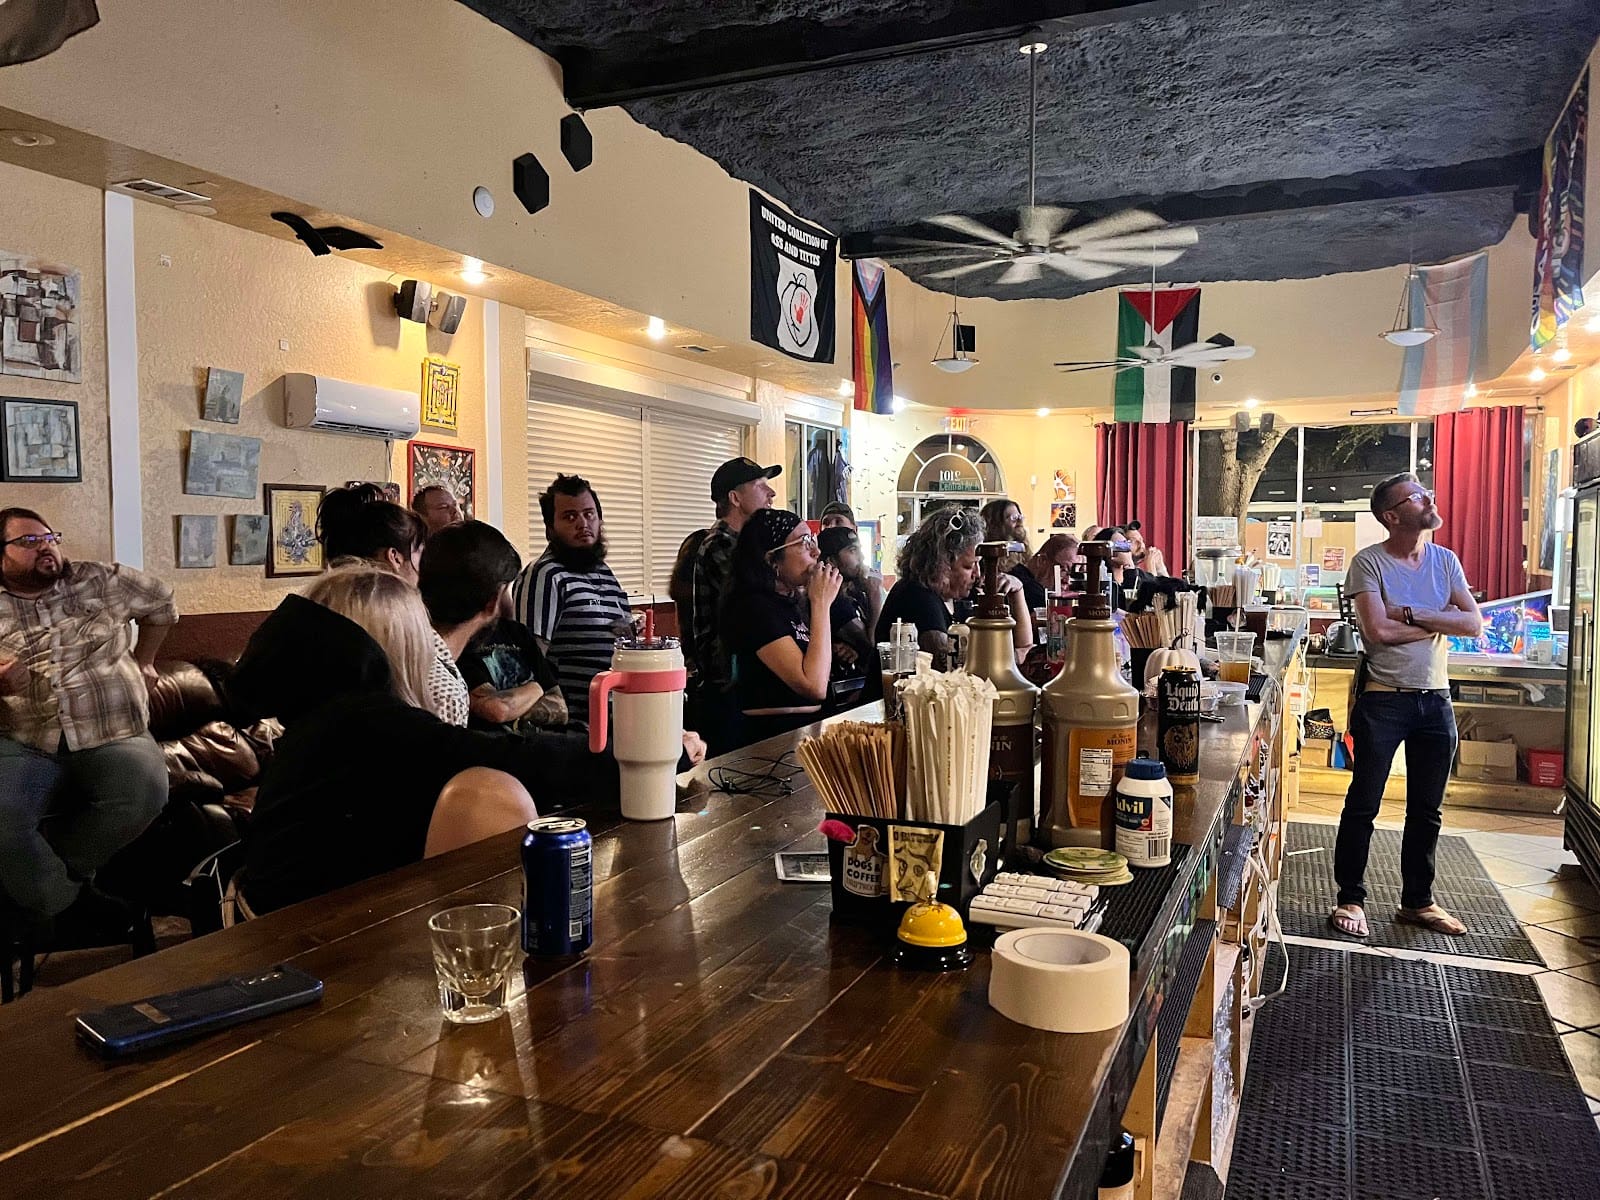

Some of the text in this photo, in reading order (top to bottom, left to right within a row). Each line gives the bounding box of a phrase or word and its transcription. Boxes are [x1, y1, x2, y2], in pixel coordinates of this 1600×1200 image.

[761, 205, 787, 233] UNITED
[787, 224, 820, 248] COALITION
[784, 241, 799, 258] AND
[950, 416, 967, 432] EXIT
[1164, 679, 1199, 700] Liquid
[1167, 697, 1199, 712] Death
[848, 857, 873, 872] DOGS
